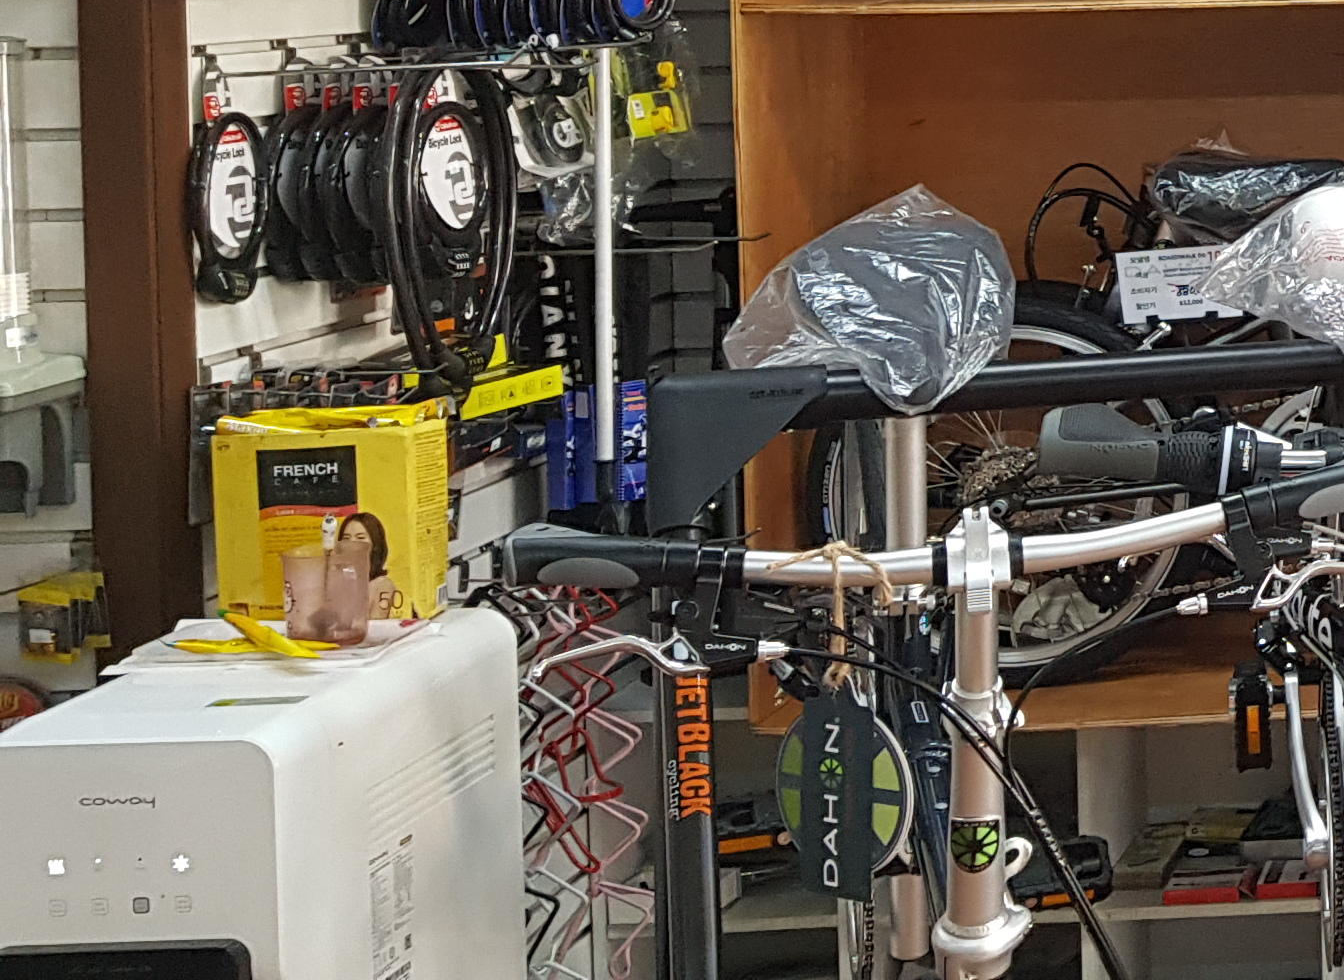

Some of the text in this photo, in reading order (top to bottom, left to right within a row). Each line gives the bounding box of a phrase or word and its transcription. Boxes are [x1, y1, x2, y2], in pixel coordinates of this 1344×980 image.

[428, 132, 463, 151] Bicycle Lock
[231, 146, 246, 159] Lock
[273, 462, 339, 478] FRENCH
[274, 476, 338, 486] CAFE
[1267, 536, 1303, 545] DAHON
[1216, 584, 1254, 600] DAHON
[378, 590, 404, 611] 50
[704, 641, 747, 652] DAHON
[675, 677, 713, 819] JETBLACK
[78, 796, 156, 808] coway
[819, 722, 844, 888] DAHON
